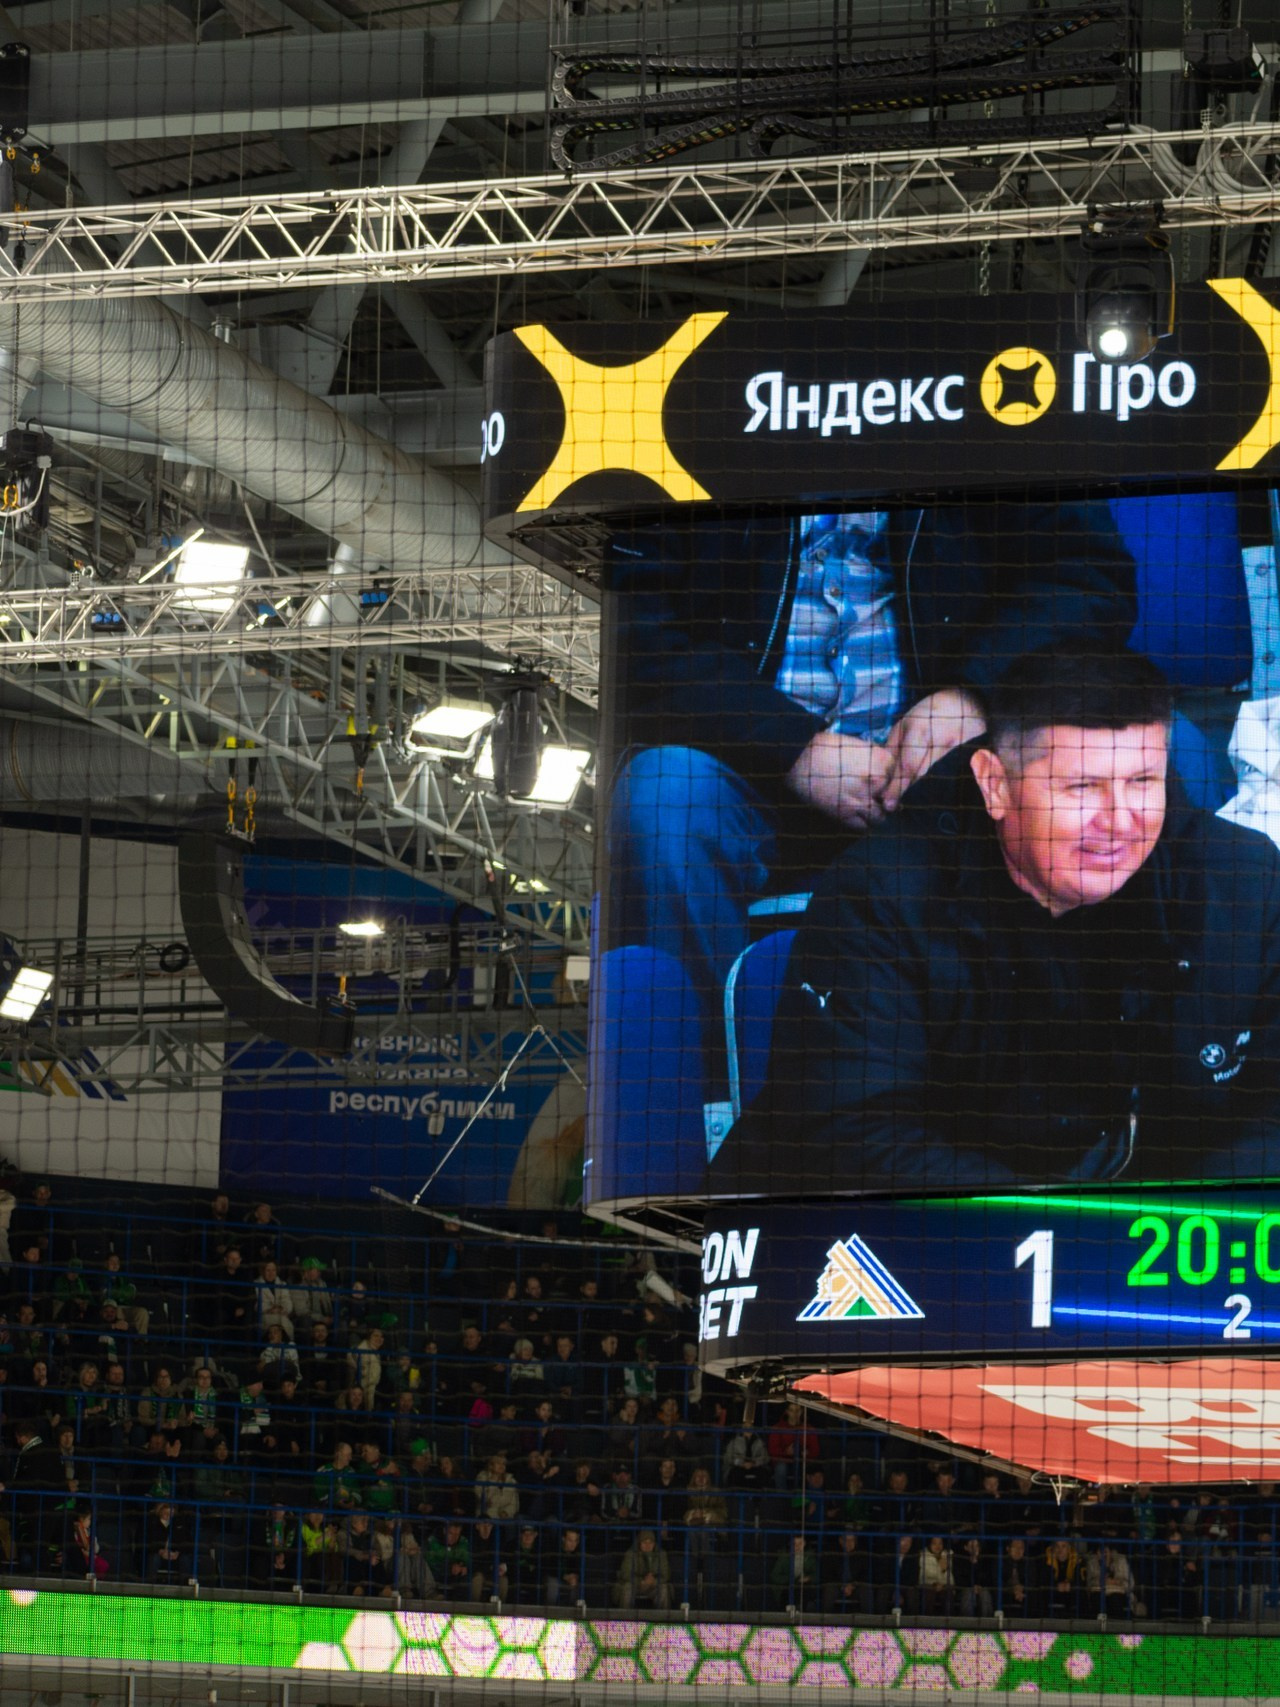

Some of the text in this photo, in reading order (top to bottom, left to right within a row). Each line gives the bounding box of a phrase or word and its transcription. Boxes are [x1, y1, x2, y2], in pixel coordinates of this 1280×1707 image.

[744, 352, 1196, 436] Яндекс Про
[329, 1090, 515, 1120] республики
[1014, 1229, 1053, 1328] 1
[1223, 1294, 1252, 1339] 2
